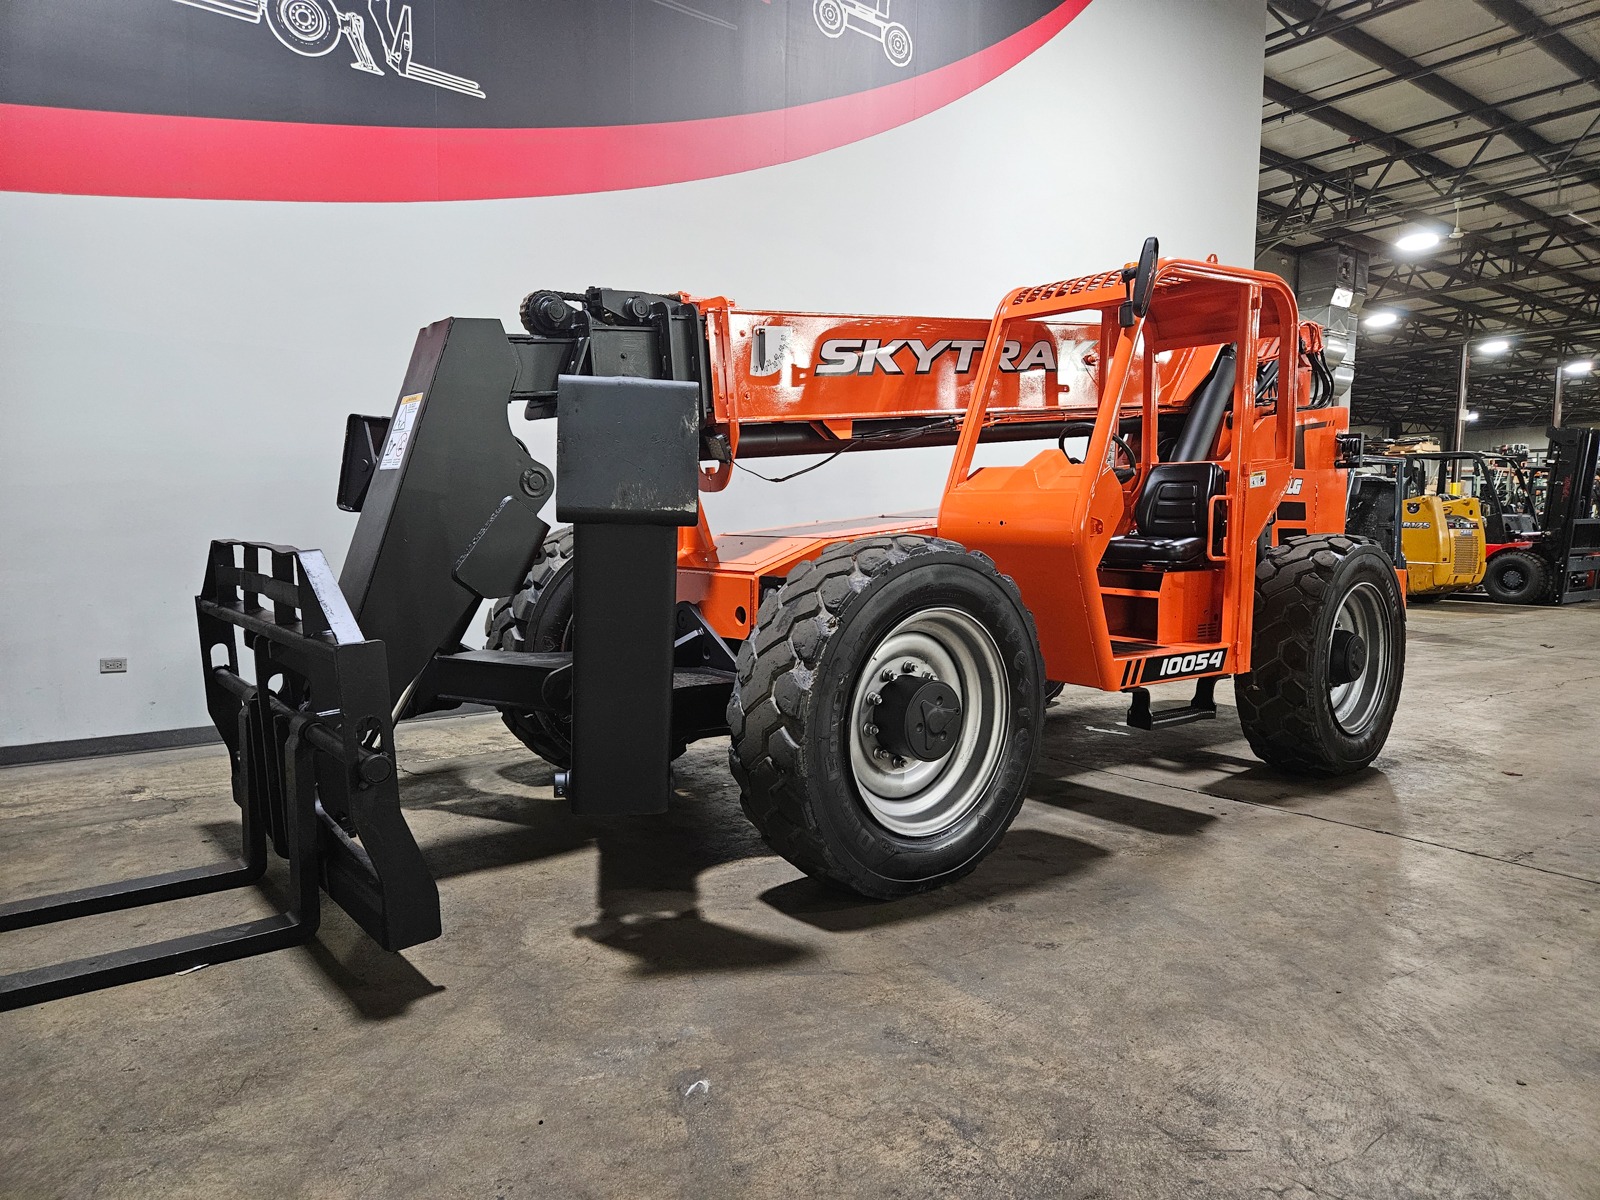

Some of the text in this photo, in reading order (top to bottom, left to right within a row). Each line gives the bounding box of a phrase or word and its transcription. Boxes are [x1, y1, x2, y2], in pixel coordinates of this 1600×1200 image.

[814, 339, 1098, 376] SKYTRAK
[1286, 478, 1304, 495] LG
[1160, 651, 1223, 676] 10054
